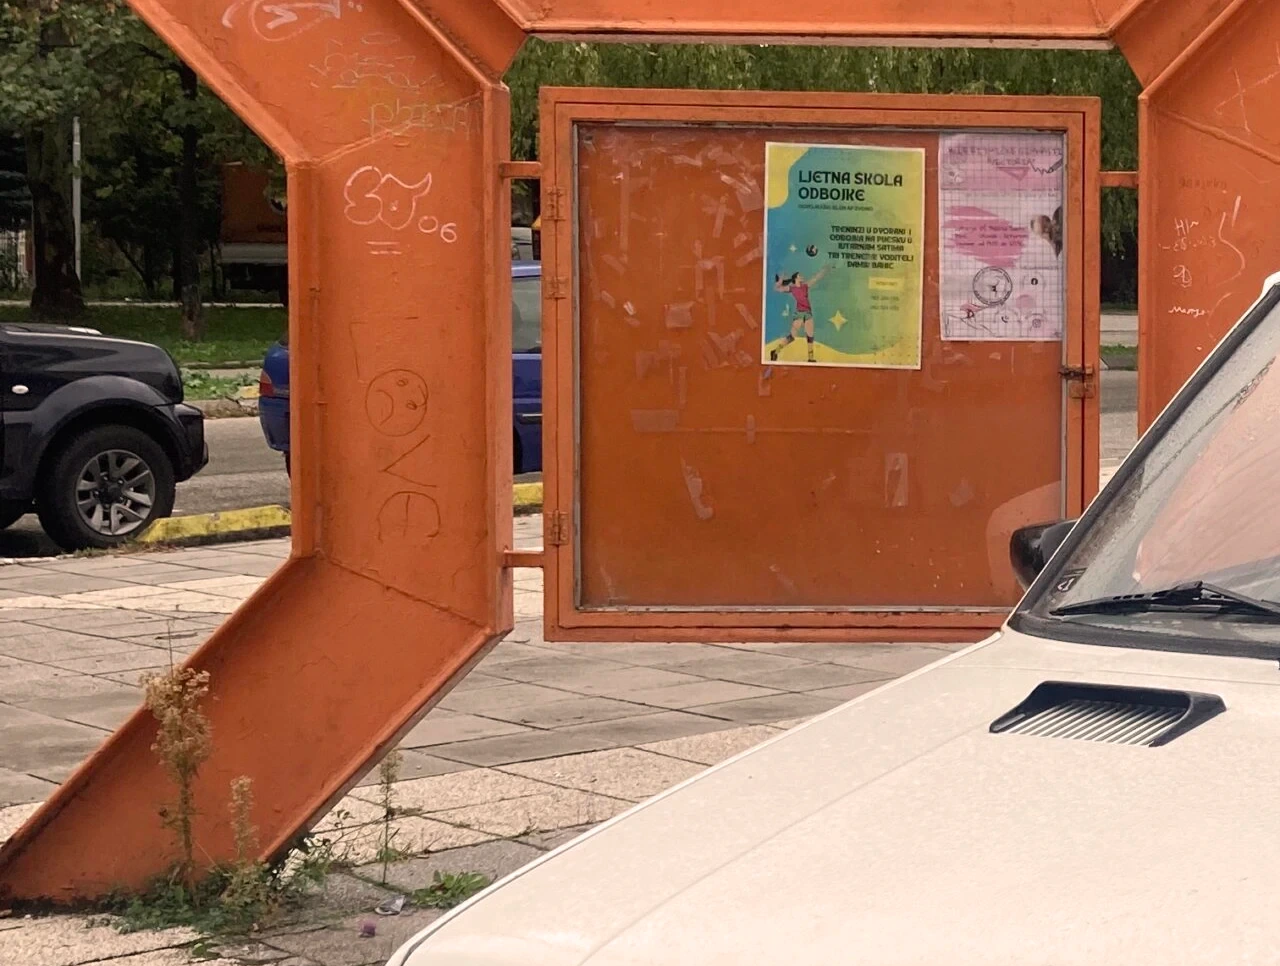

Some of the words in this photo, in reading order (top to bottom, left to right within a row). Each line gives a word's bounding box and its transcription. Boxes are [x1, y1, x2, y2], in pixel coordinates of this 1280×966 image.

[798, 170, 851, 185] LJETNA
[854, 172, 903, 187] SKOLA
[798, 186, 866, 202] ODBOJKE
[873, 227, 906, 235] DVORANI
